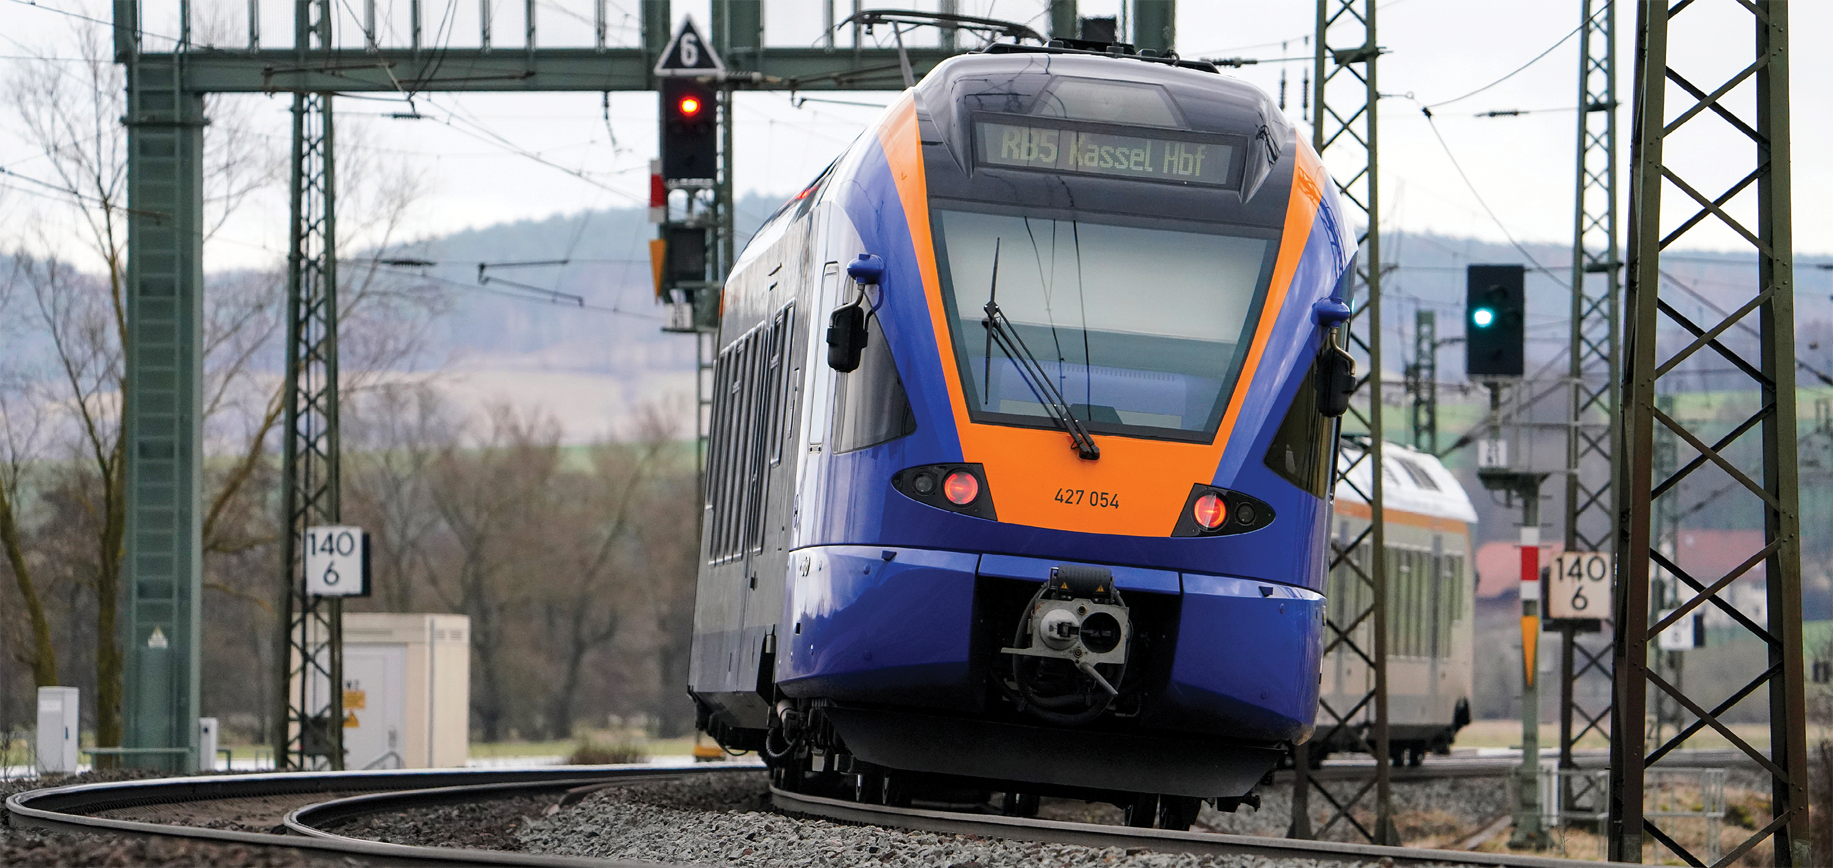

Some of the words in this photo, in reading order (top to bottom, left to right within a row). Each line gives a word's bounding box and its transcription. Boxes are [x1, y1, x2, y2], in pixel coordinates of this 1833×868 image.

[680, 32, 698, 68] 6
[1001, 126, 1059, 163] RB5
[1069, 132, 1153, 172] Kassel
[1163, 142, 1206, 177] Hbf
[1054, 488, 1085, 505] 427
[1089, 491, 1119, 509] 054
[307, 531, 355, 557] 140
[323, 560, 340, 587] 6
[1555, 555, 1606, 582] 140
[1571, 586, 1588, 611] 6
